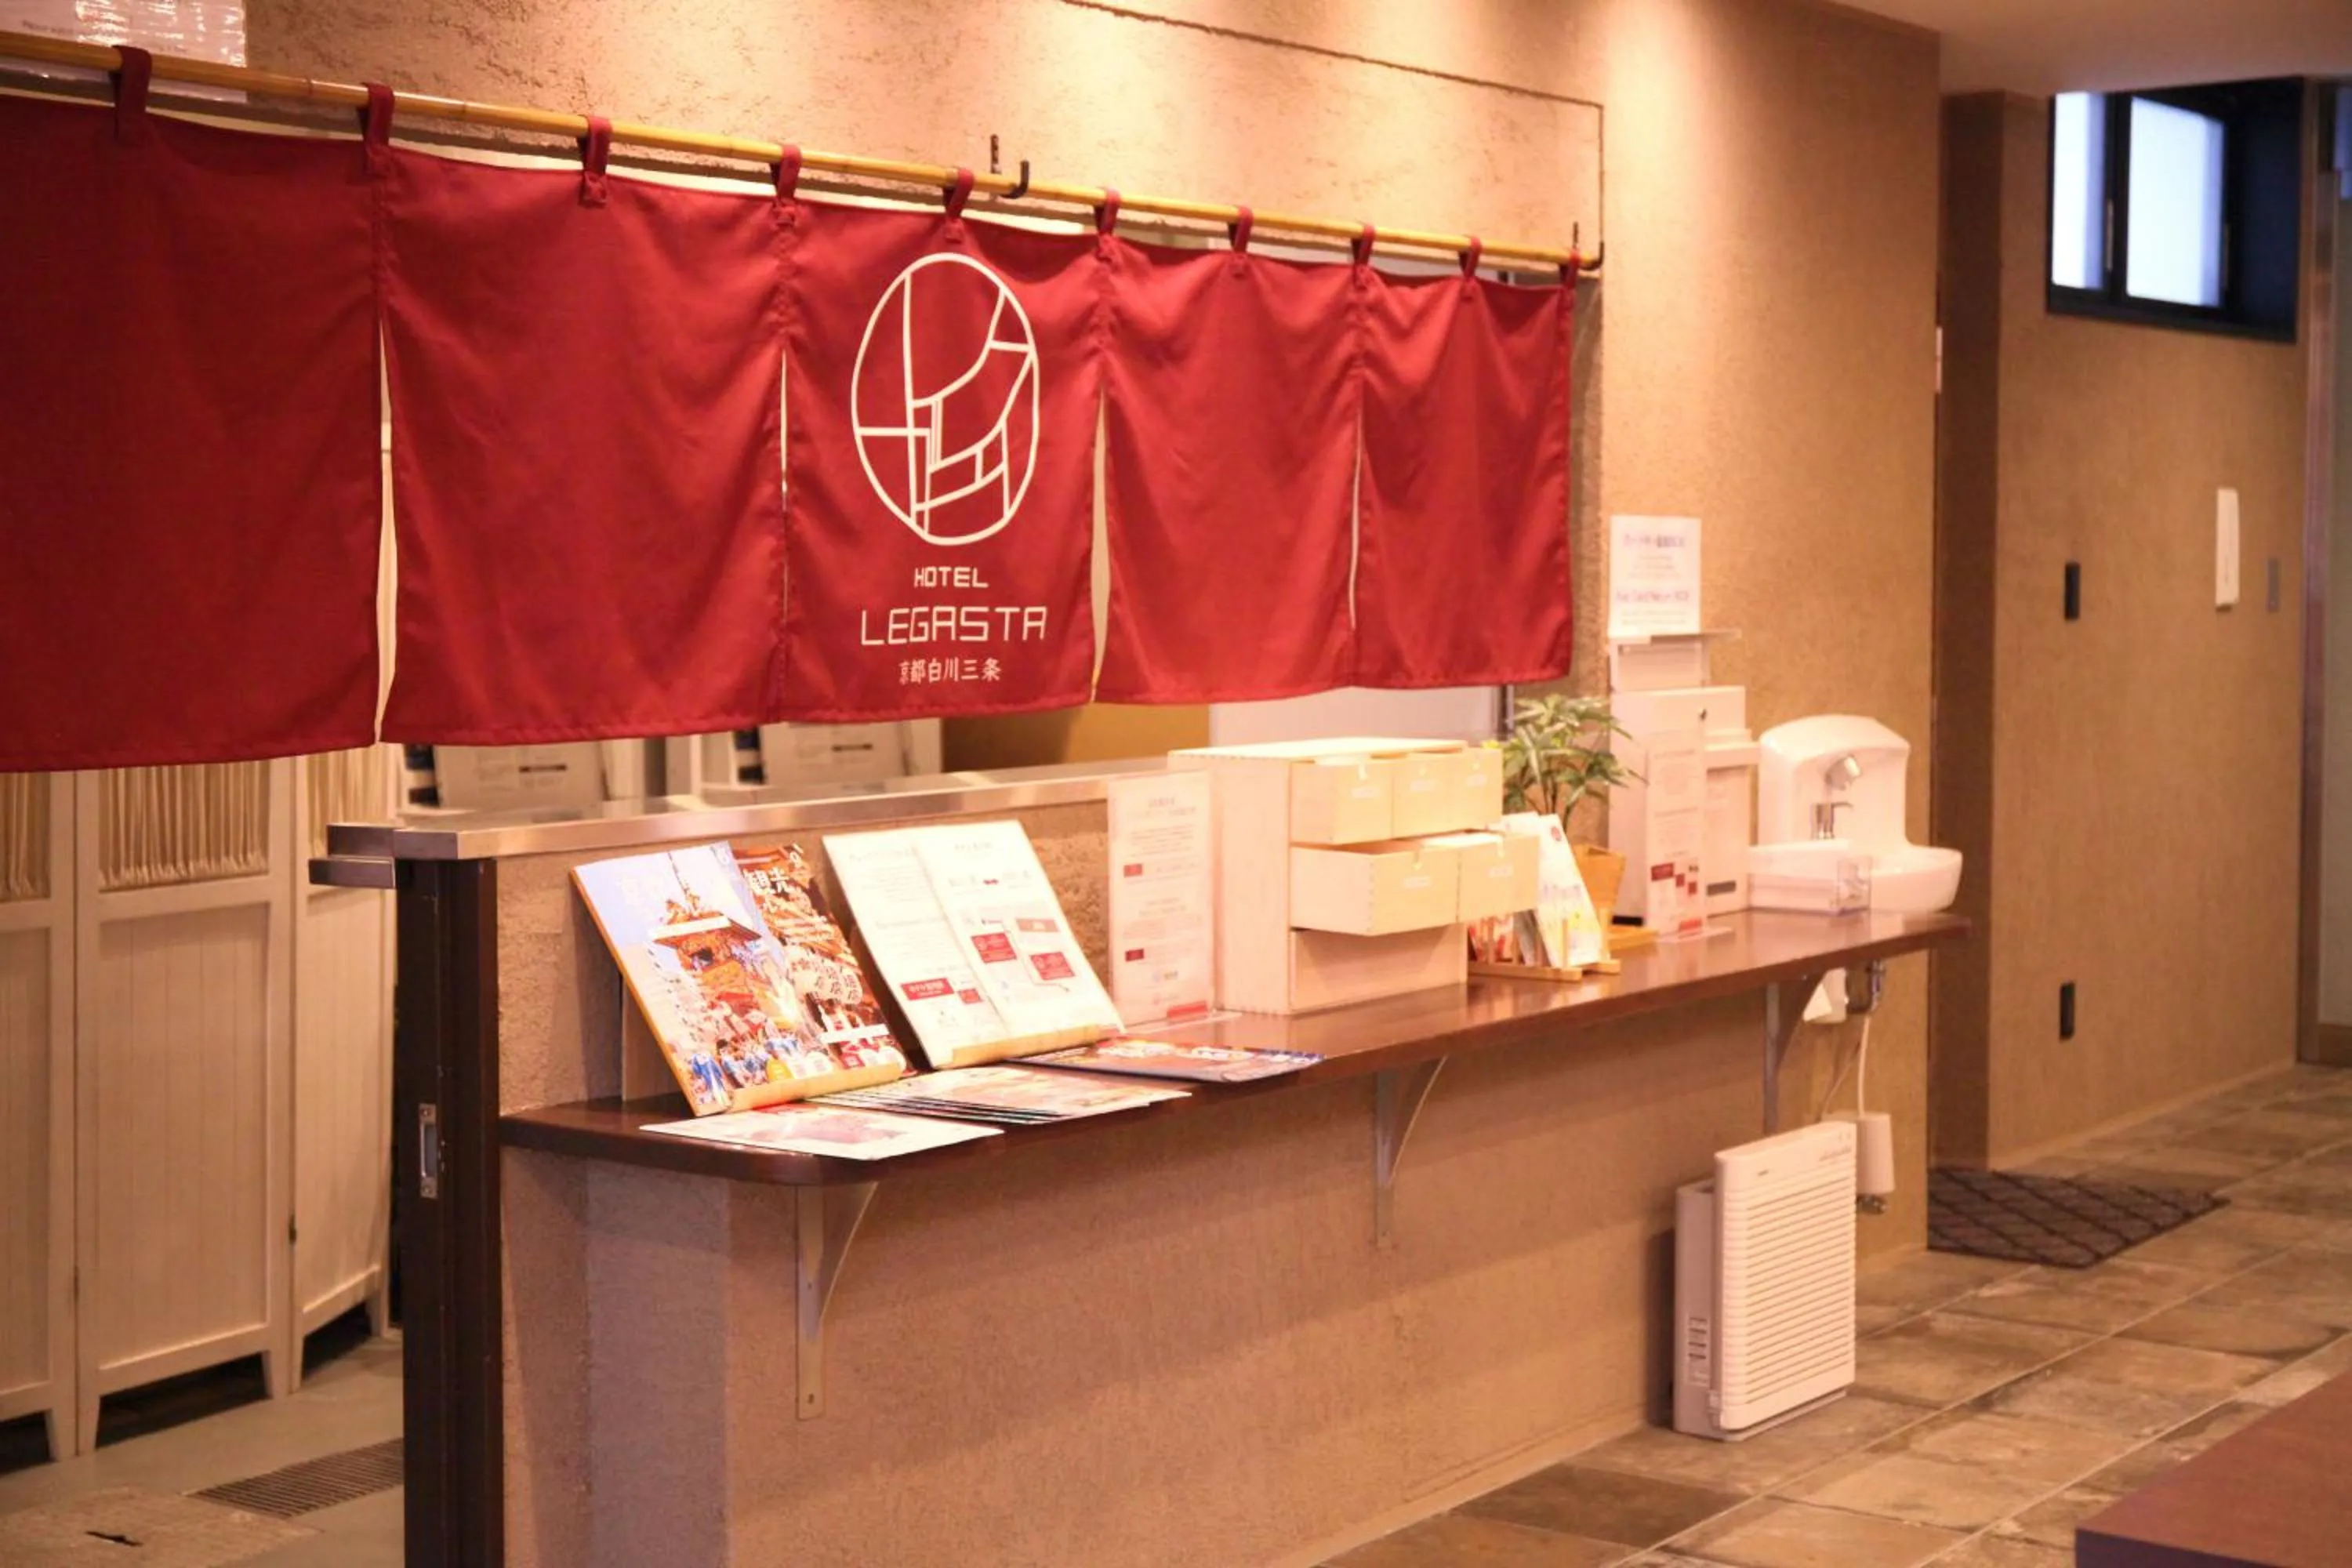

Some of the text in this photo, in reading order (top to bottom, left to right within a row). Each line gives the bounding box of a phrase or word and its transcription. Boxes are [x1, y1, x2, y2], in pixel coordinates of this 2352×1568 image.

[914, 566, 989, 588] HOTEL
[861, 606, 1047, 645] LEGASTA
[899, 657, 1001, 684] 京都白川三条
